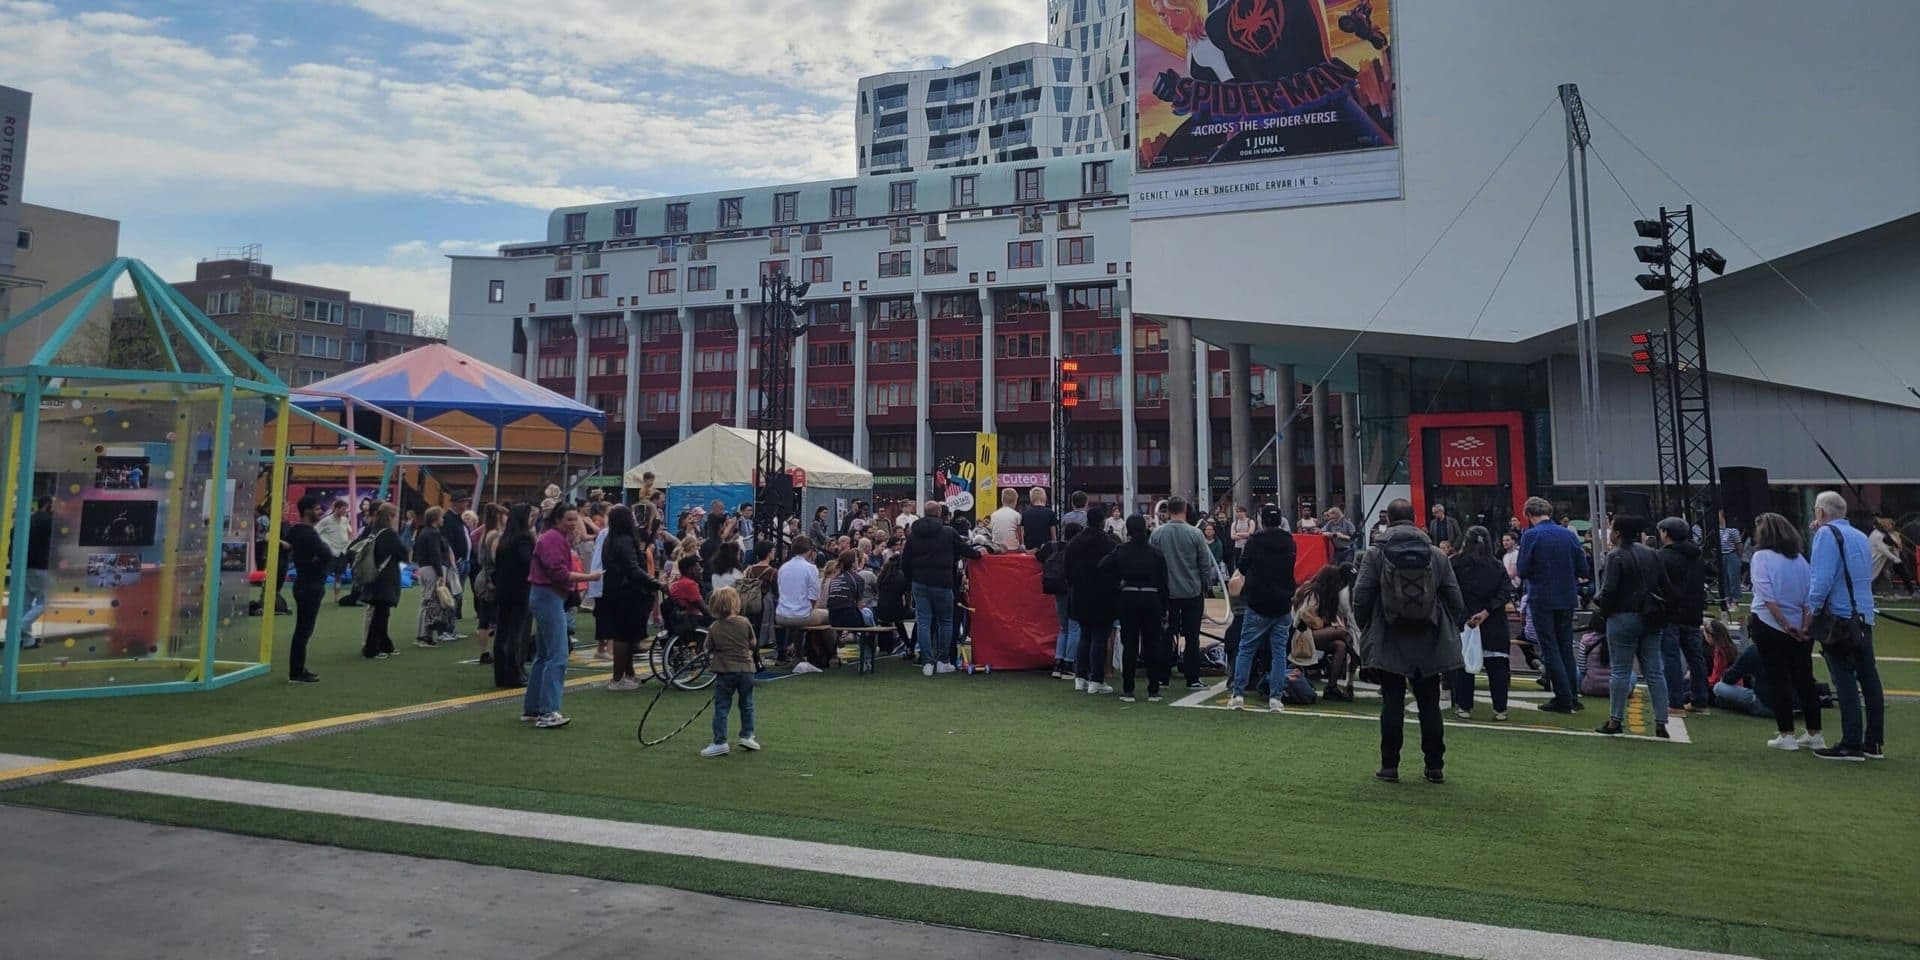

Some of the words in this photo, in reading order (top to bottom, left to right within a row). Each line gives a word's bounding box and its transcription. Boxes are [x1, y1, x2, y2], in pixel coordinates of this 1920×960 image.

[1174, 60, 1357, 115] SPIDER-MAN
[1192, 121, 1234, 137] ACROSS
[1239, 119, 1258, 131] THE
[1263, 111, 1337, 129] SPIDER-VERSE
[1245, 137, 1251, 148] 1
[1254, 135, 1279, 148] JUNI
[1261, 146, 1286, 154] IMAX
[1140, 190, 1169, 201] GENIET
[1174, 188, 1189, 198] VAN
[1194, 186, 1209, 196] EEN
[1214, 182, 1260, 195] ONGEKENDE
[981, 443, 990, 466] 10
[1445, 456, 1493, 468] JACK'S
[959, 461, 975, 480] 10
[1455, 469, 1483, 477] CASINO
